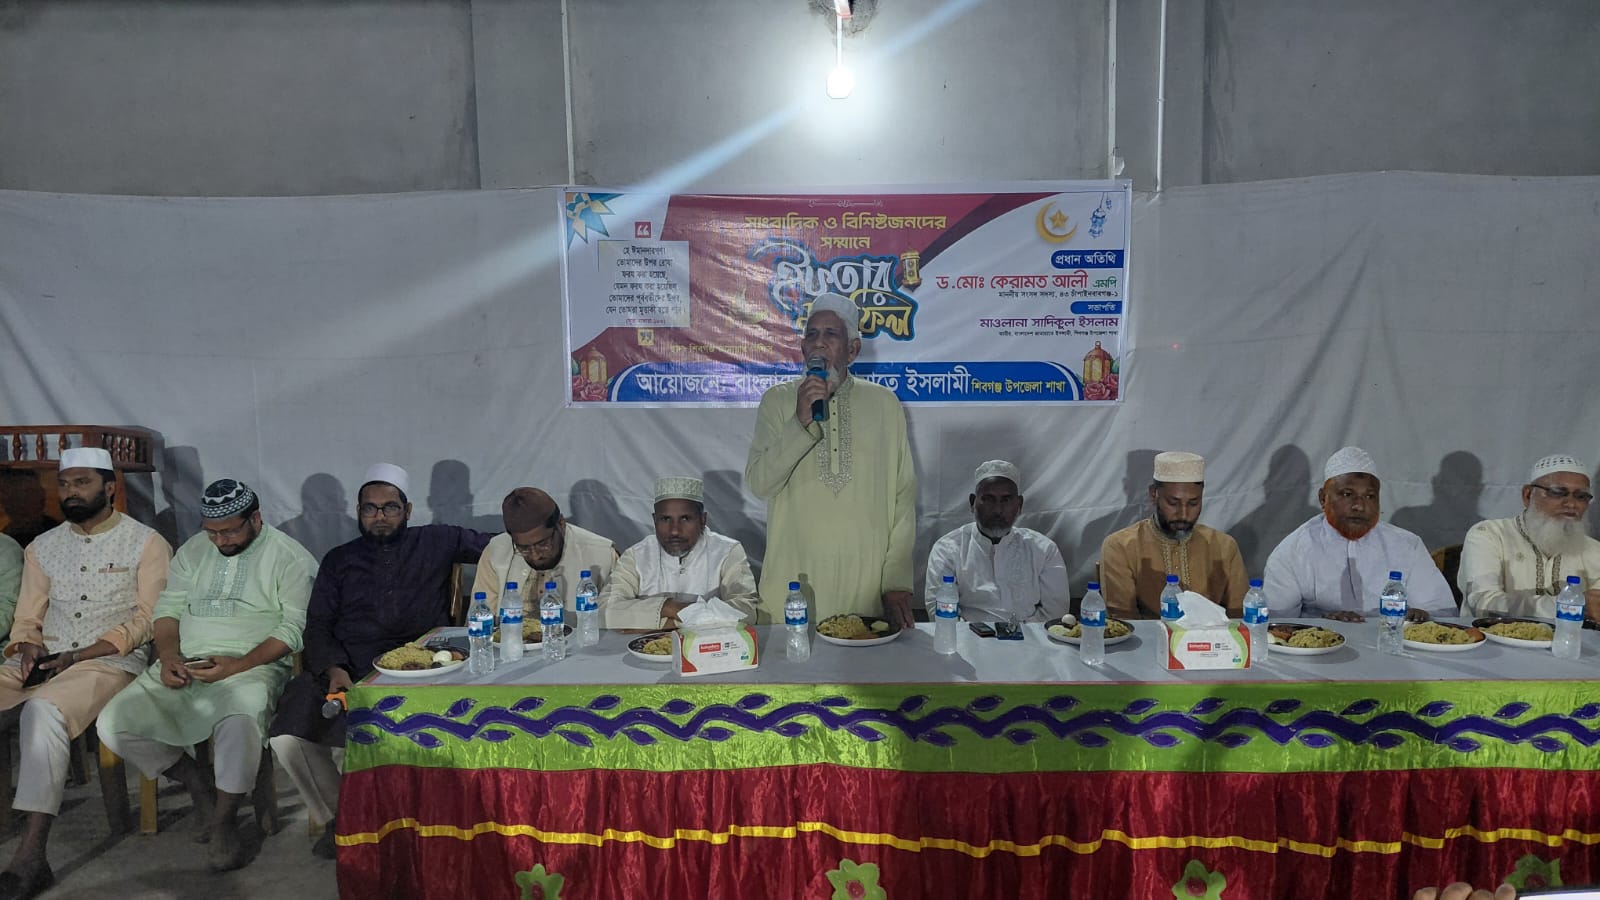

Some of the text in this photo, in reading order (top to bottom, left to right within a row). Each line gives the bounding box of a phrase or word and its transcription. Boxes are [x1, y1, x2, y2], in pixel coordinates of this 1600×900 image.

[744, 212, 946, 230] সাংবাদিক ও বিশিষ্টজনদের
[1055, 252, 1116, 266] প্রধান অতিথি
[990, 274, 1048, 290] কেরামত
[1052, 269, 1088, 289] আলী
[1092, 278, 1118, 289] এমপি
[1088, 302, 1116, 312] সভাপতি
[980, 318, 1028, 328] মাওলানা
[1078, 316, 1119, 328] ইসলাম
[905, 365, 971, 396] ইসলামী
[971, 378, 1066, 394] শিবগঞ্জ উপজেলা শাখা
